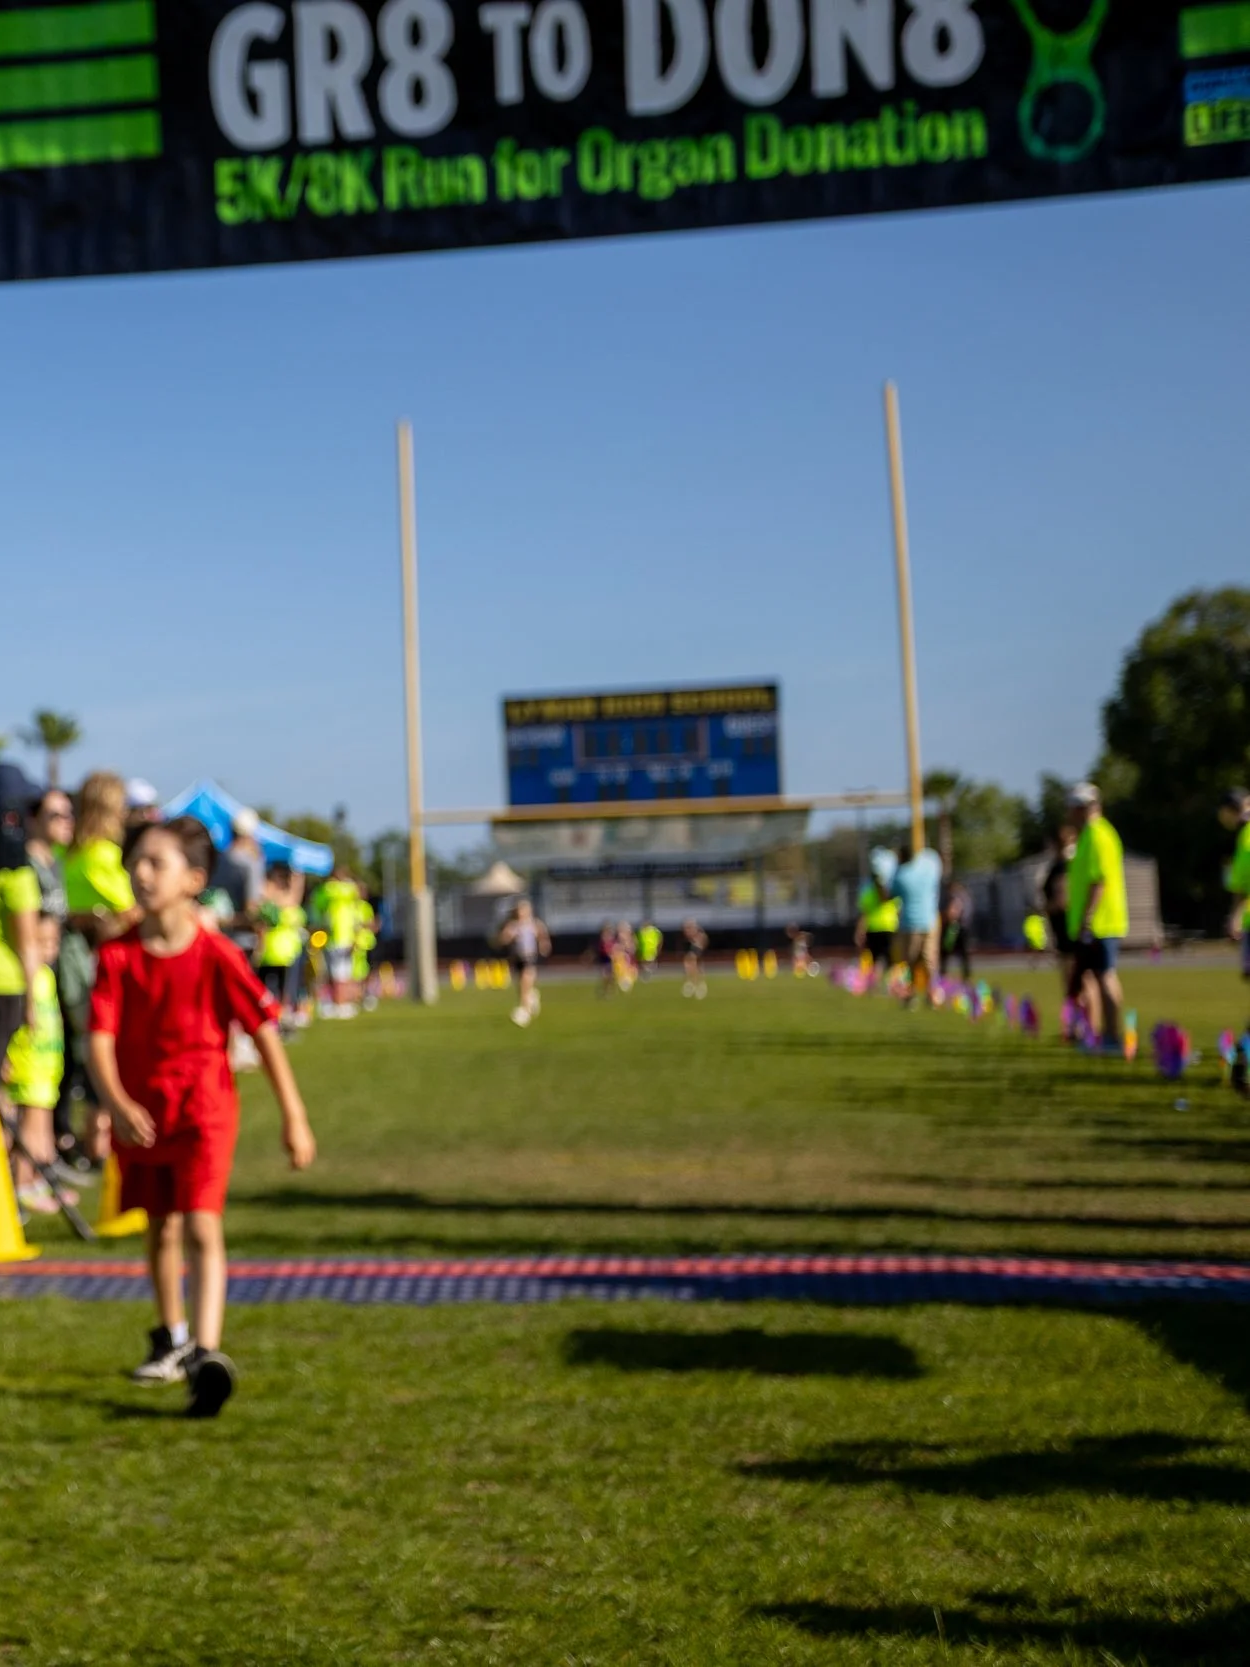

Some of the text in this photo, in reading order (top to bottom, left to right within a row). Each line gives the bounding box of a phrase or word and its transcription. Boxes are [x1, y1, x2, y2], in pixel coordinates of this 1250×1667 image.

[209, 0, 985, 150] GR8 TO DON8
[381, 146, 487, 211] Run
[493, 138, 571, 200] for
[576, 126, 736, 199] Organ
[744, 100, 987, 180] Donation
